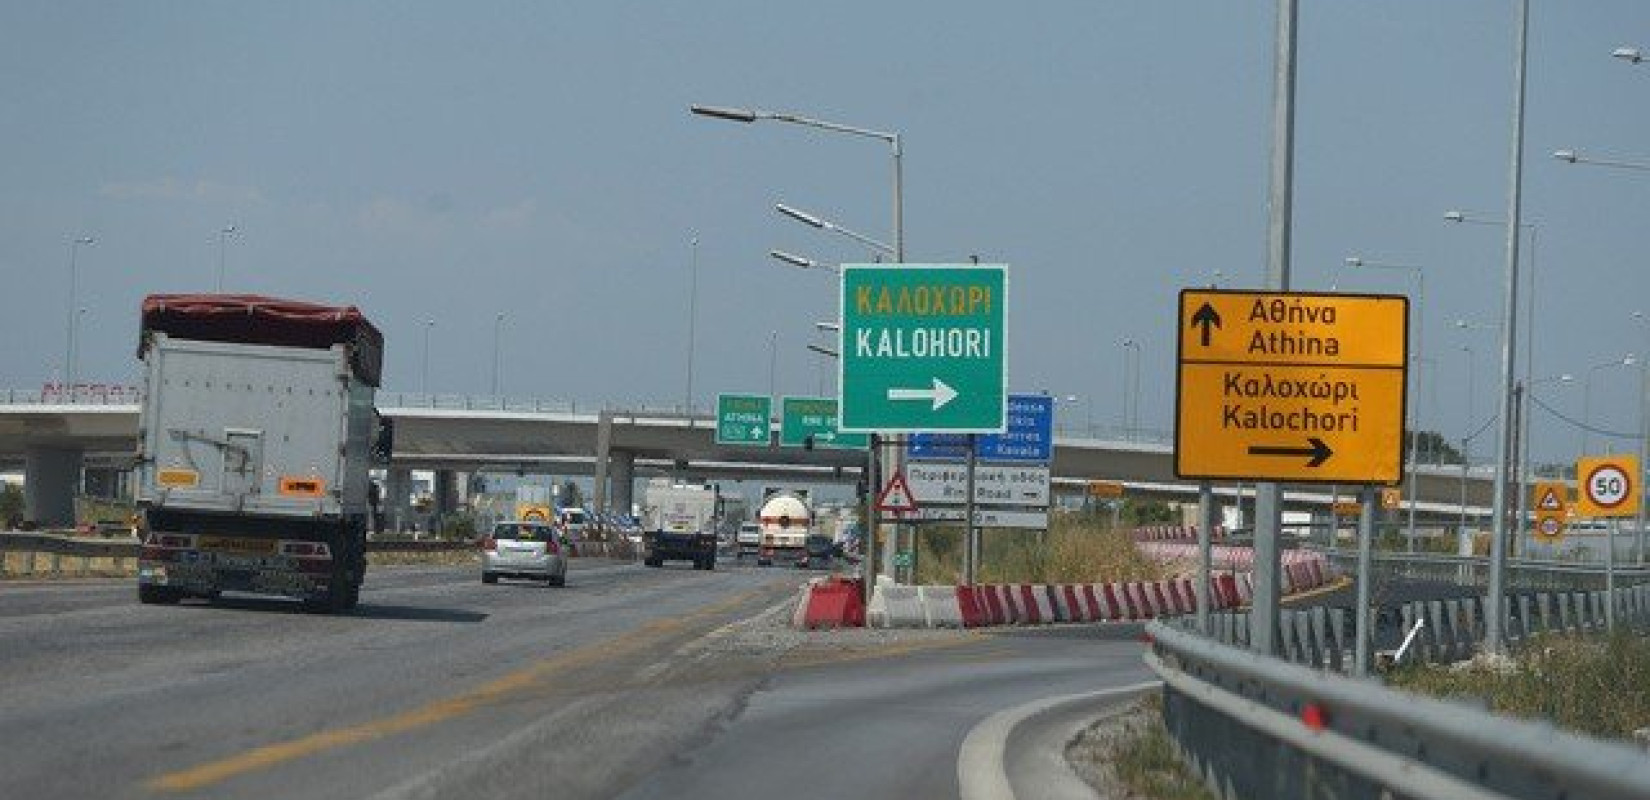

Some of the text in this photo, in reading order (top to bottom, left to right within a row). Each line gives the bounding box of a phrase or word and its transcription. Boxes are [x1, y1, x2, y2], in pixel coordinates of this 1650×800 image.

[856, 286, 991, 315] ΚΑΛΟΧΩΡΙ
[1248, 298, 1336, 324] Αθήνα
[856, 328, 991, 357] KALOHORI
[1248, 330, 1340, 356] Athina
[1222, 372, 1360, 405] Καλοχώρι
[1222, 405, 1358, 432] Kalochori
[1595, 476, 1621, 496] 50
